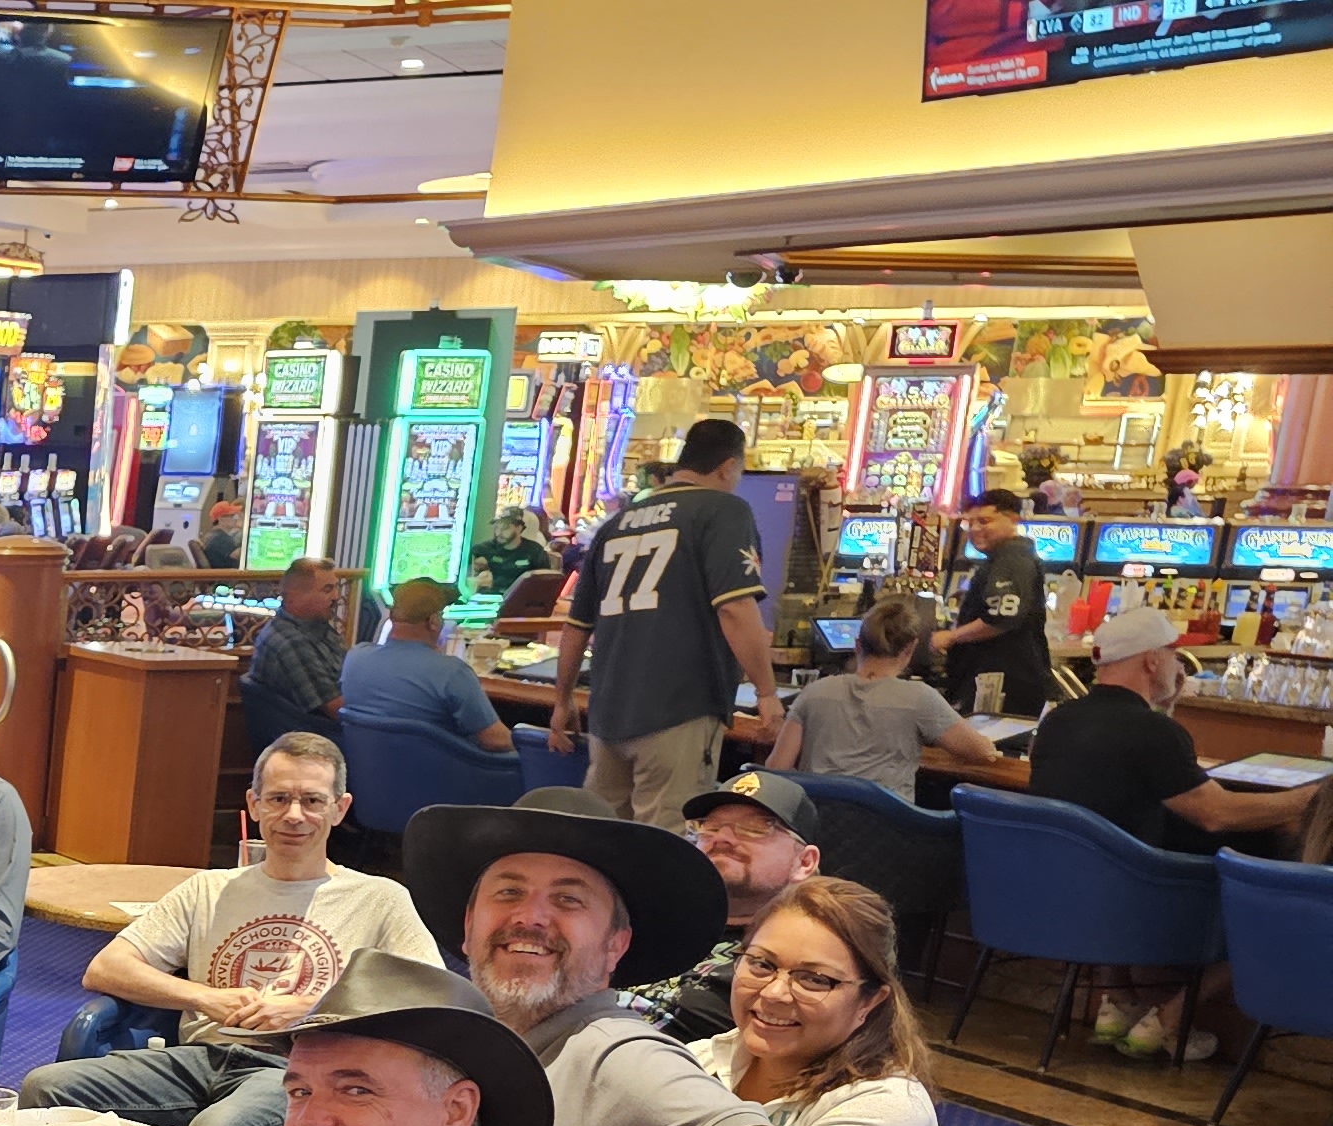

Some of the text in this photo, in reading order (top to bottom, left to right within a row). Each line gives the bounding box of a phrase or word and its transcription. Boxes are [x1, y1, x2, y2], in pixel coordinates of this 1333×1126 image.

[1089, 13, 1104, 27] 82
[1117, 5, 1142, 21] IND
[1038, 18, 1064, 34] LVA
[275, 362, 318, 378] CASINO
[424, 362, 475, 378] CASINO
[271, 380, 317, 393] WIZARD
[421, 380, 475, 394] WIZARD
[599, 528, 680, 616] 77
[233, 926, 288, 951] SCHOOL
[292, 929, 311, 946] OF
